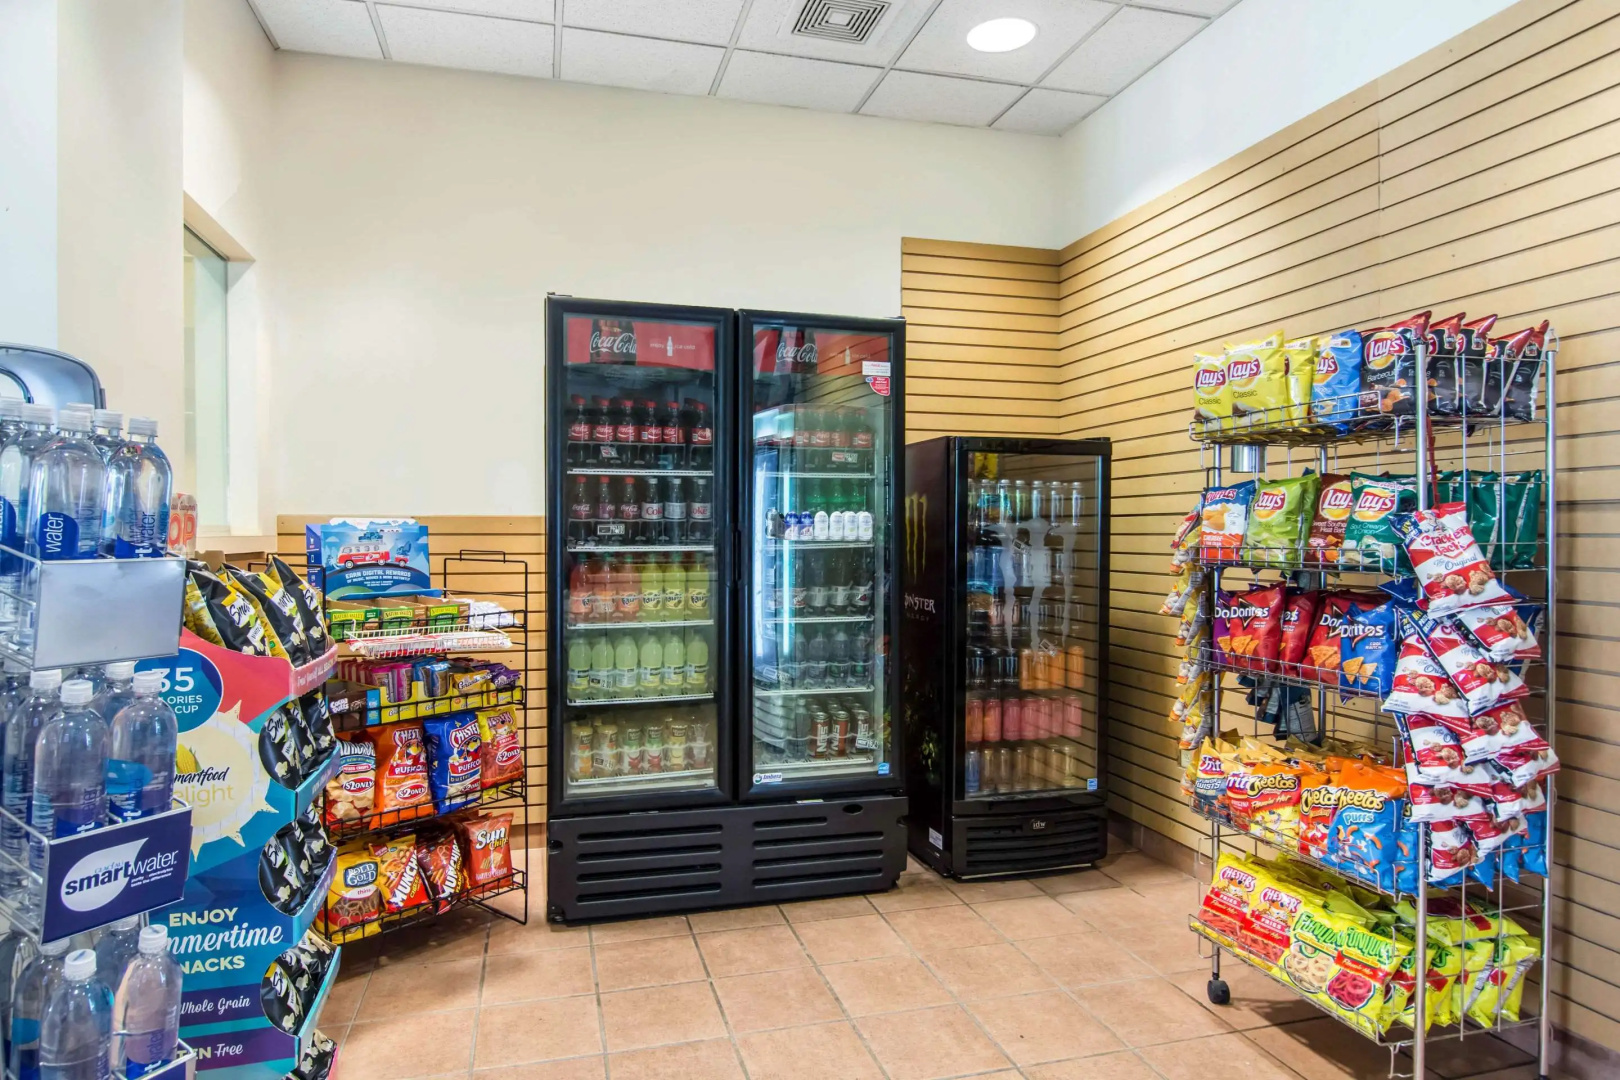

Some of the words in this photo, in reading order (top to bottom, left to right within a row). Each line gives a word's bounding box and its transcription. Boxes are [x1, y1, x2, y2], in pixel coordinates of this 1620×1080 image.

[590, 331, 637, 354] Coca-Cola
[1368, 337, 1404, 360] Lay's
[776, 342, 818, 363] Coca-Cola
[1228, 356, 1261, 380] Lay's
[1196, 368, 1226, 389] Lay's
[1198, 397, 1222, 406] Classic
[1233, 389, 1258, 400] Classic
[692, 507, 707, 515] oke
[1354, 492, 1393, 512] Lay's
[169, 513, 196, 549] OP
[1421, 527, 1470, 547] Cracker
[1435, 541, 1464, 556] Jack
[1445, 553, 1478, 571] Original
[345, 571, 362, 579] EARN
[385, 570, 412, 578] REWARDS
[904, 592, 936, 614] ONSTER
[1230, 606, 1269, 618] Doritos
[1340, 623, 1384, 638] Doritos
[169, 695, 203, 704] ORIES
[330, 697, 348, 706] COCOA
[174, 705, 199, 714] CUP
[173, 766, 230, 785] martfood
[1248, 774, 1297, 797] Cheetos
[173, 784, 234, 807] elight
[475, 827, 506, 850] Sun
[347, 871, 377, 886] GOLD
[348, 863, 375, 875] ROLD
[1219, 893, 1238, 905] FRIES
[169, 907, 238, 927] ENJOY
[1261, 917, 1282, 930] FRIES
[166, 922, 284, 955] mmertime
[181, 955, 245, 975] NACKS
[217, 995, 251, 1015] Grain
[214, 1043, 244, 1057] Free
